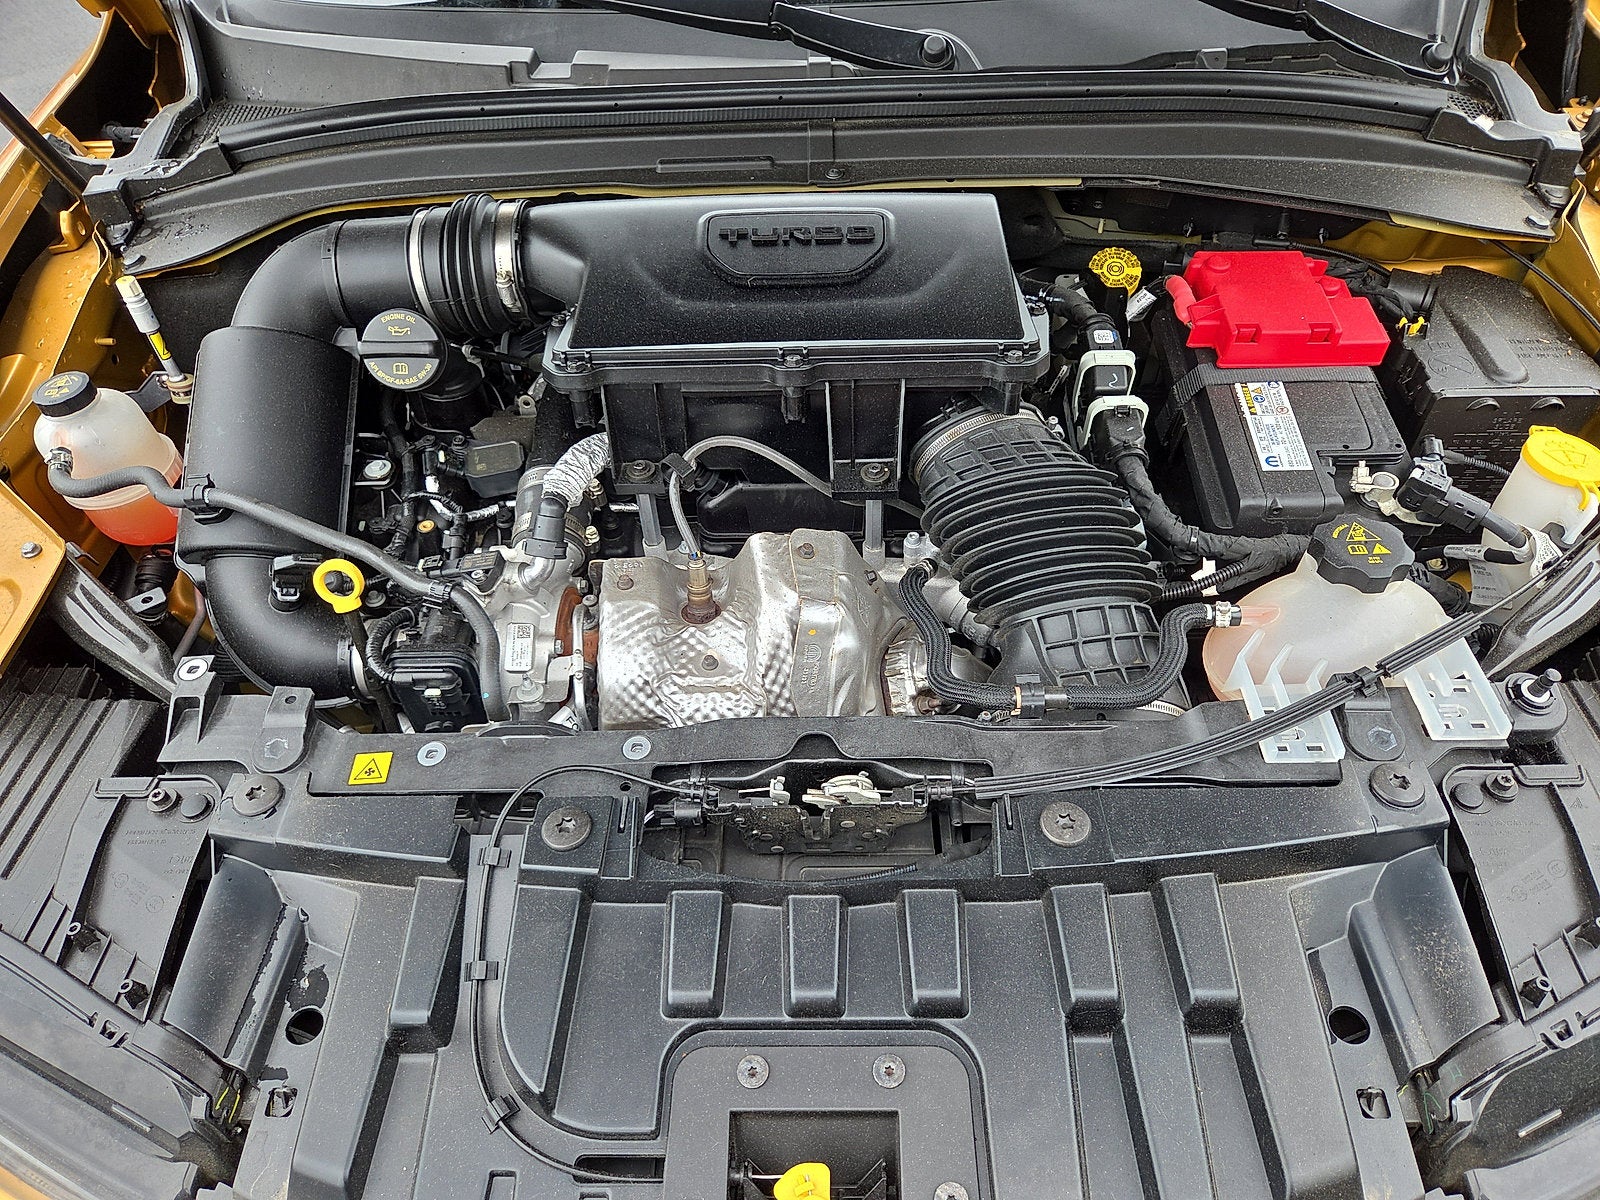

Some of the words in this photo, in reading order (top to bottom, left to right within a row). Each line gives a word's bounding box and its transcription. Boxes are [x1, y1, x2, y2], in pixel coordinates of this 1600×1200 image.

[718, 226, 876, 244] TURBO
[381, 314, 404, 323] ENGINE
[405, 314, 416, 324] OIL
[369, 361, 378, 373] API
